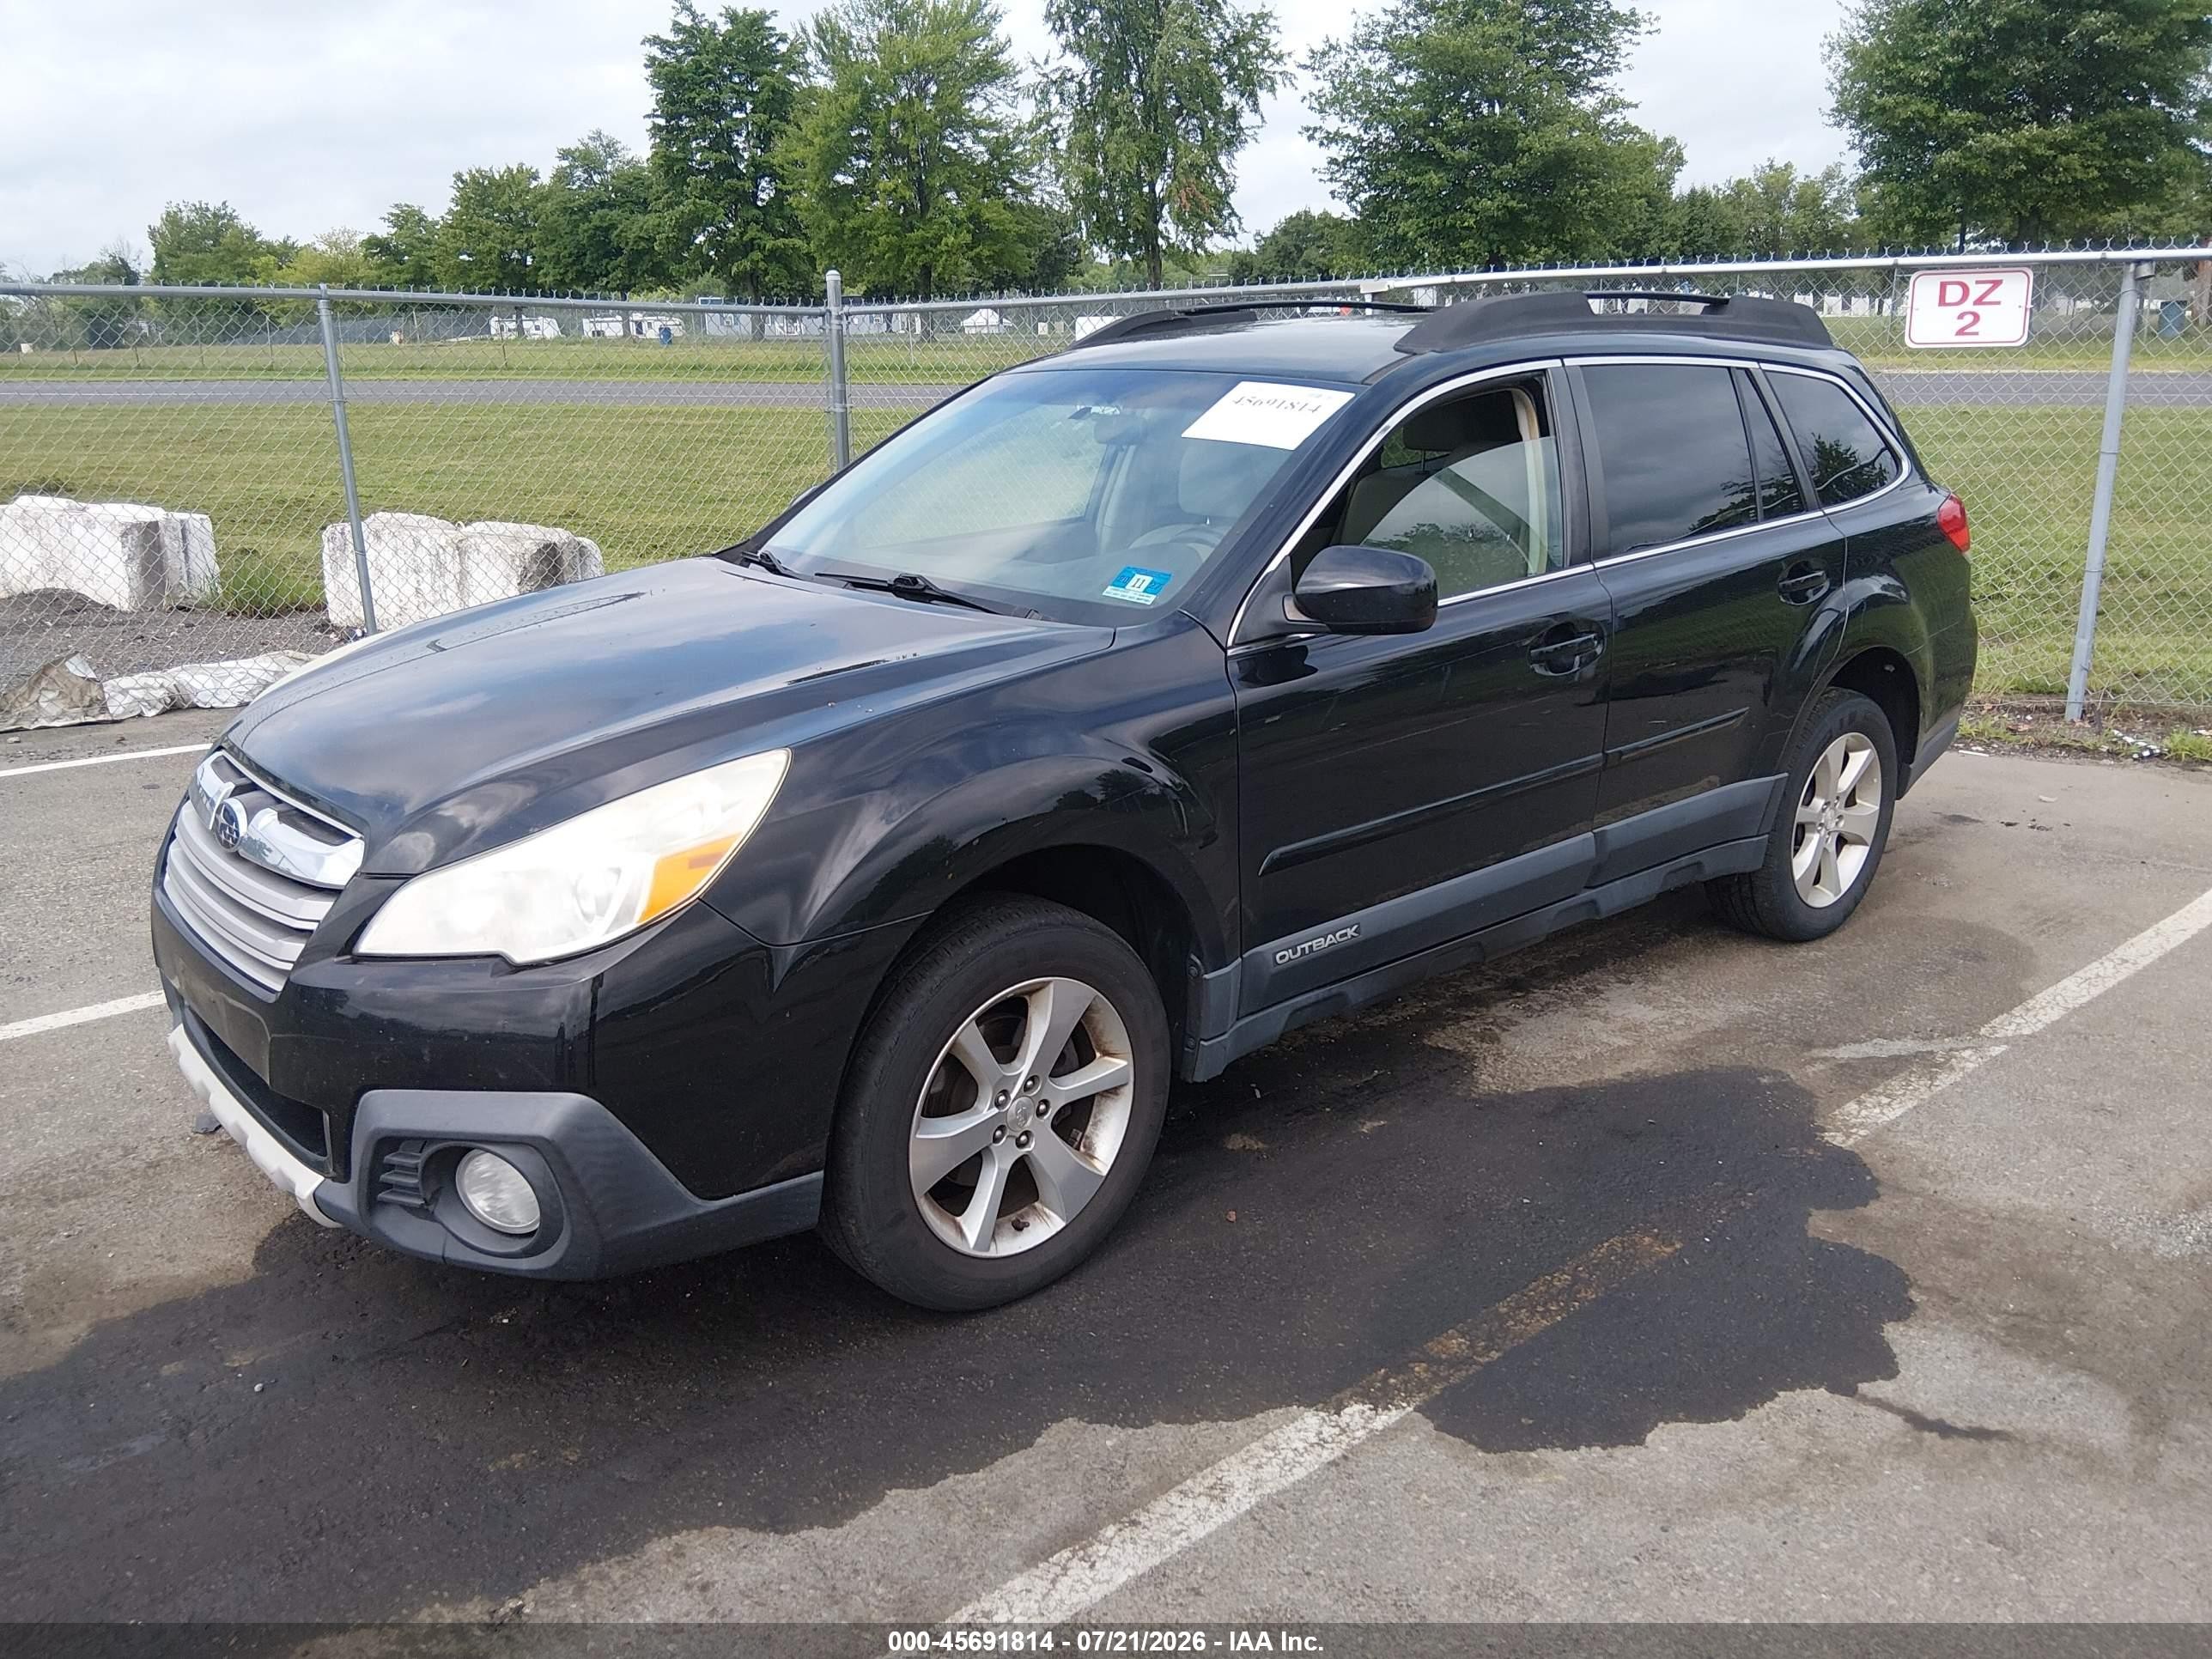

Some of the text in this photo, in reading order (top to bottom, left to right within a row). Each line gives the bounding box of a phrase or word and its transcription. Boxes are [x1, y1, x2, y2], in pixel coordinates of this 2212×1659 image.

[1938, 279, 2003, 307] DZ
[1954, 311, 1981, 336] 2
[1275, 924, 1359, 964] OUTBACK
